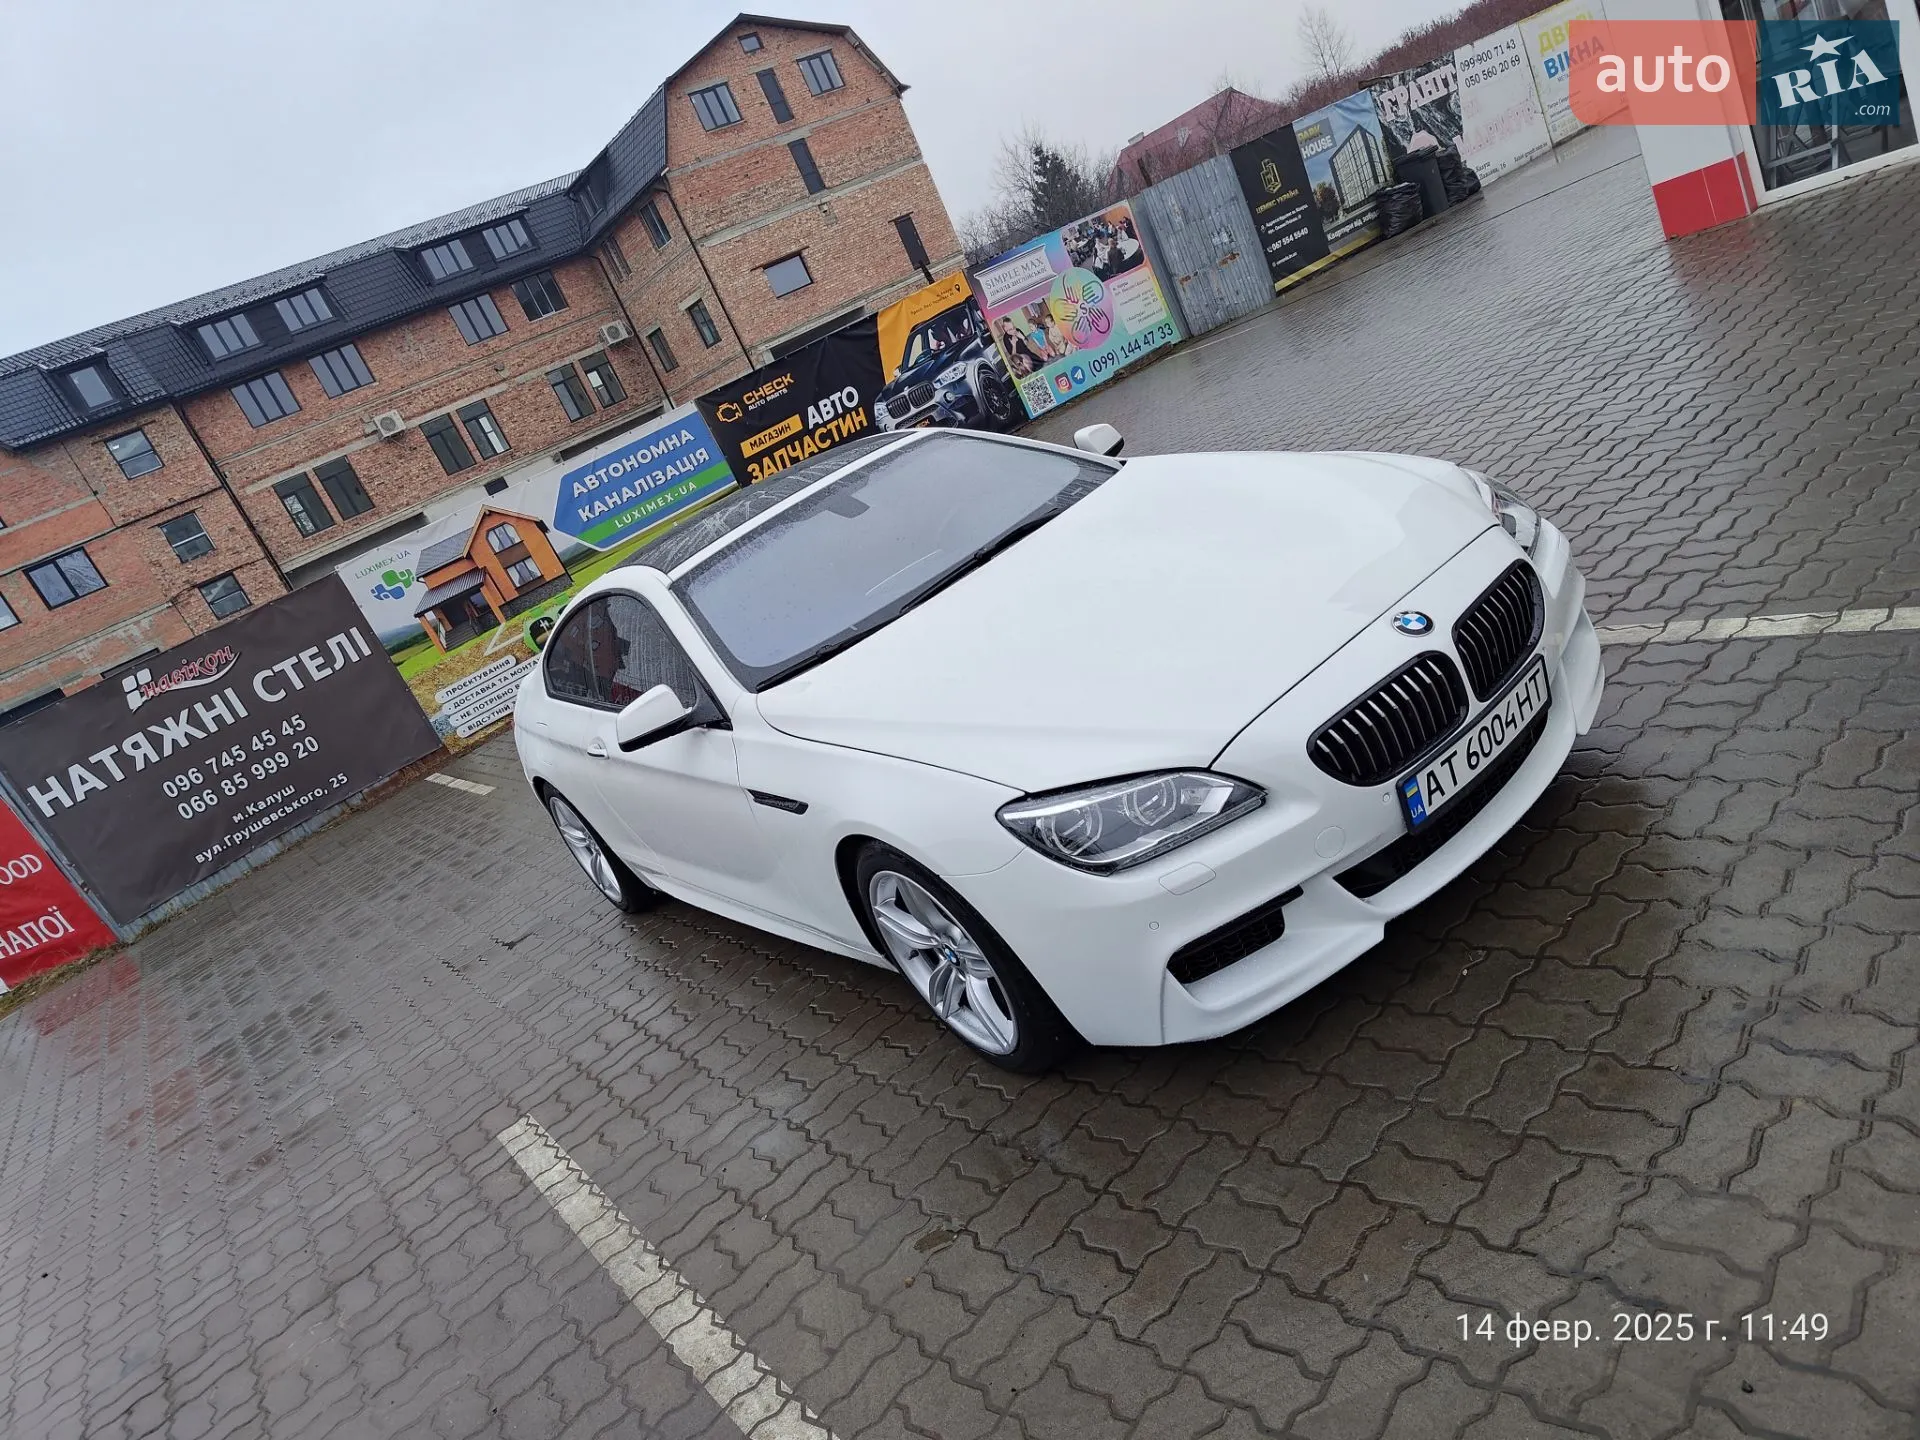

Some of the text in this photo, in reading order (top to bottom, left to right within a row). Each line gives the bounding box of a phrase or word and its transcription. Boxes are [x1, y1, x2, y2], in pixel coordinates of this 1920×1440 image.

[1494, 44, 1505, 58] 71
[1506, 38, 1517, 51] 43
[1464, 54, 1521, 88] 050 560 20 69
[1297, 124, 1321, 144] PARK
[1300, 135, 1333, 159] HOUSE
[985, 258, 1044, 290] SIMPLE MAX
[1088, 322, 1174, 378] (099) 144 47 33
[743, 373, 794, 406] CHECK
[748, 388, 788, 411] AUTO PARTS
[807, 386, 859, 430] АВТО
[747, 407, 868, 486] ЗАПЧАСТИН
[749, 423, 792, 451] МАГАЗИН
[572, 429, 695, 498] АВТОНОМНА
[577, 447, 710, 522] КАНАЛІЗАЦІЯ
[453, 682, 497, 709] ДОСТАВКА
[498, 676, 510, 685] ТА
[460, 711, 472, 720] НЕ
[472, 688, 514, 713] ПОТРІБНО
[26, 626, 372, 818] НАТЯЖНІ СТЕЛІ
[467, 705, 511, 731] ВІДСУТНІЙ
[162, 714, 306, 798] 096 745 45 45
[1426, 750, 1458, 808] AT
[1465, 699, 1518, 771] 6004
[177, 736, 319, 819] 066 85 999 20
[328, 772, 349, 789] 25
[232, 784, 296, 823] м.Калуш
[1410, 805, 1424, 819] UA
